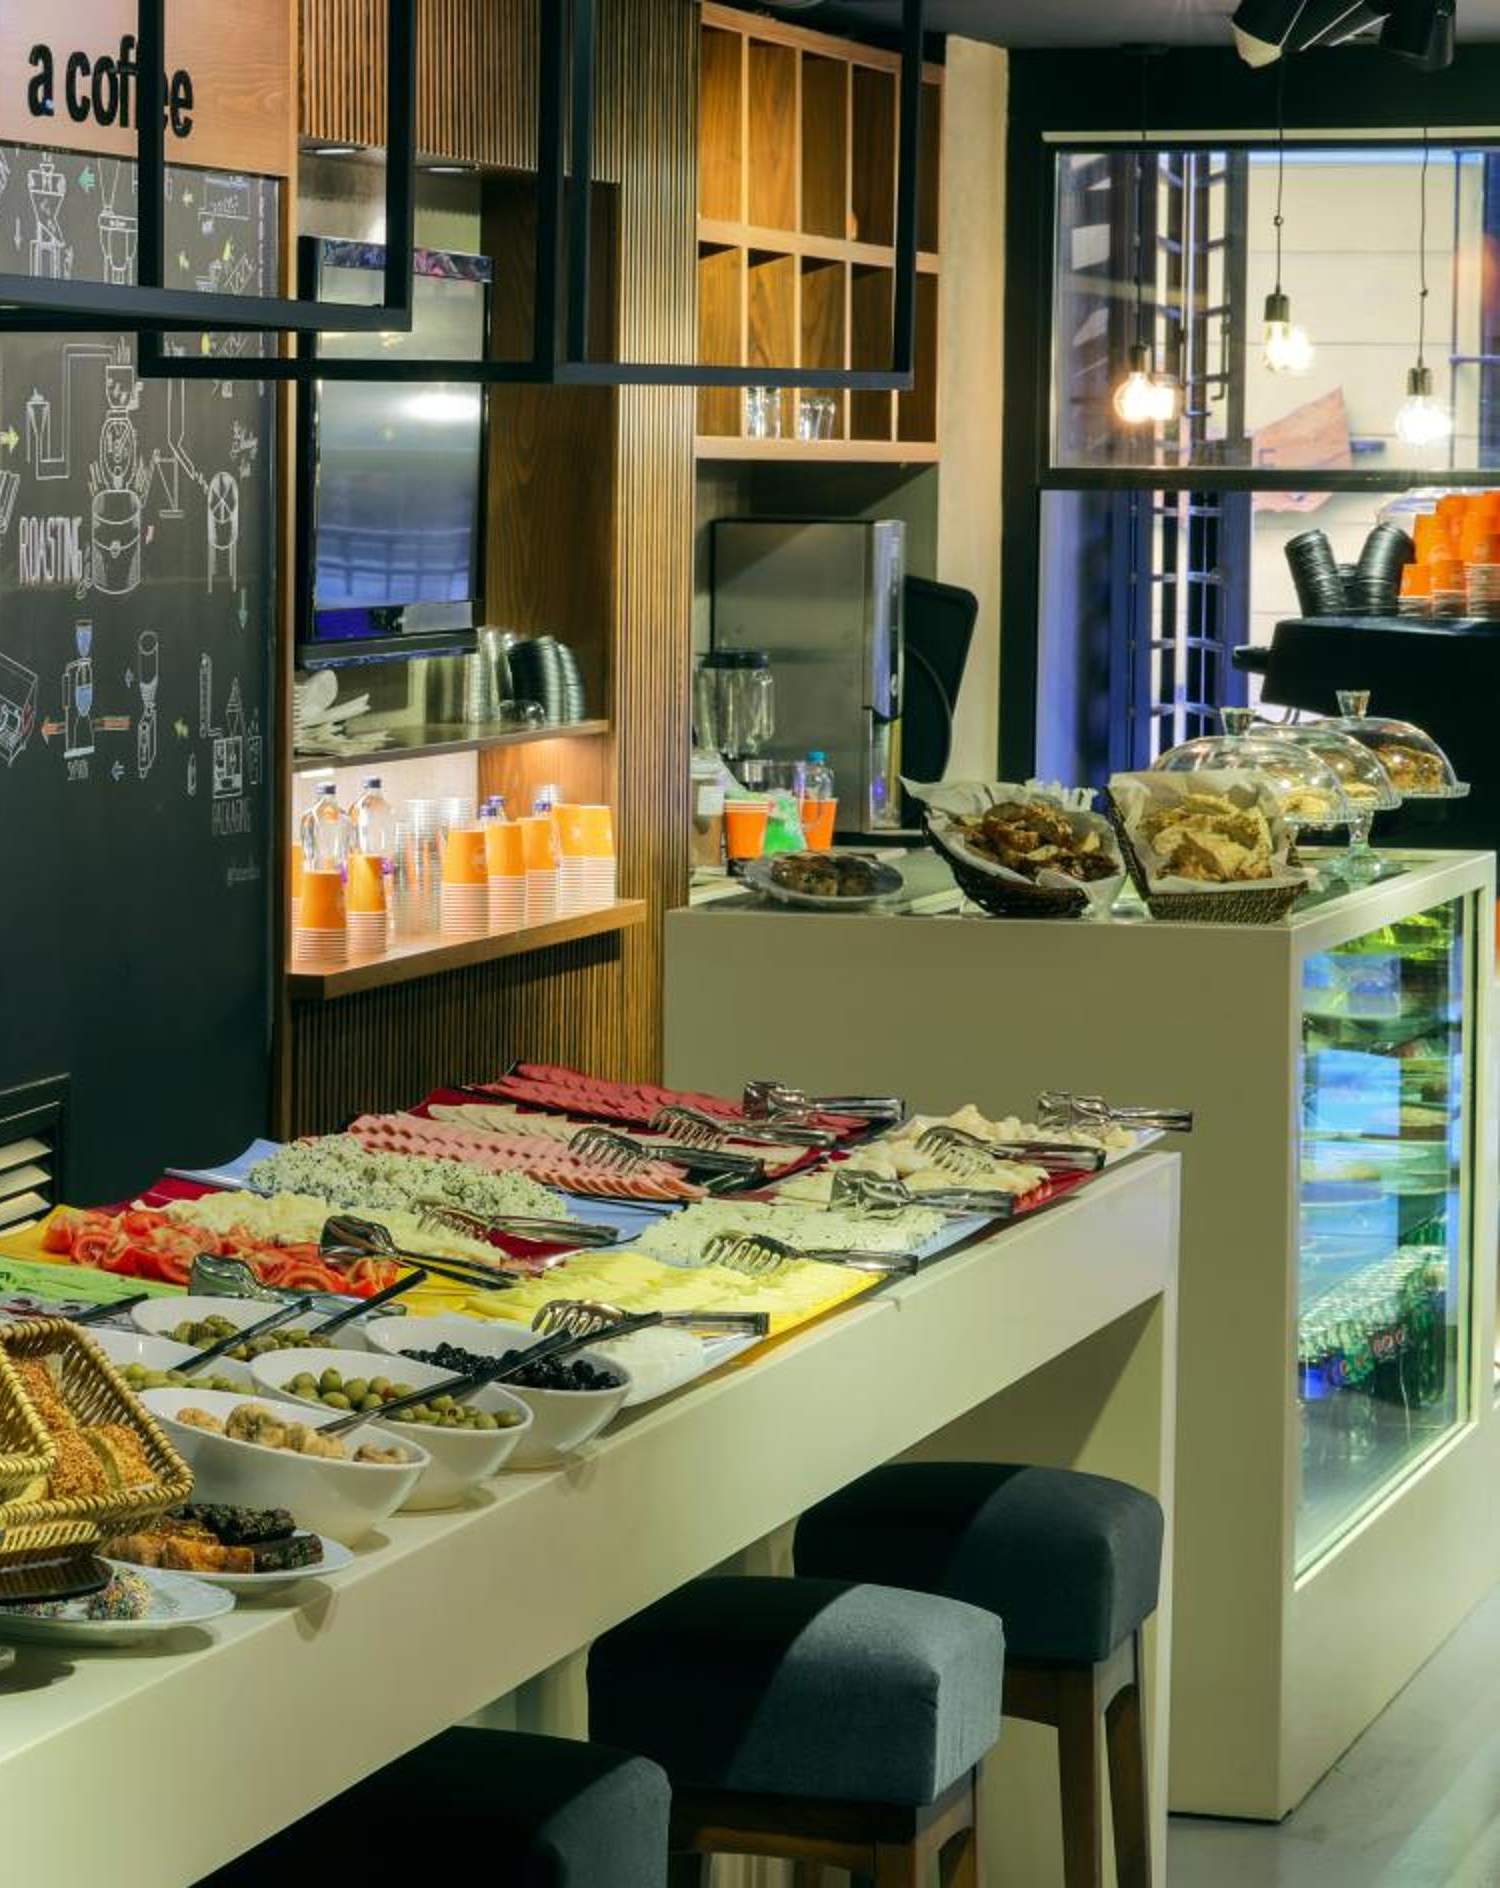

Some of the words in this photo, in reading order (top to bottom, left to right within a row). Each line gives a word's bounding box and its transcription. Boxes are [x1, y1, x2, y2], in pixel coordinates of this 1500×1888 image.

[27, 43, 54, 117] a
[65, 34, 193, 139] cofe
[19, 515, 83, 585] ROASTING
